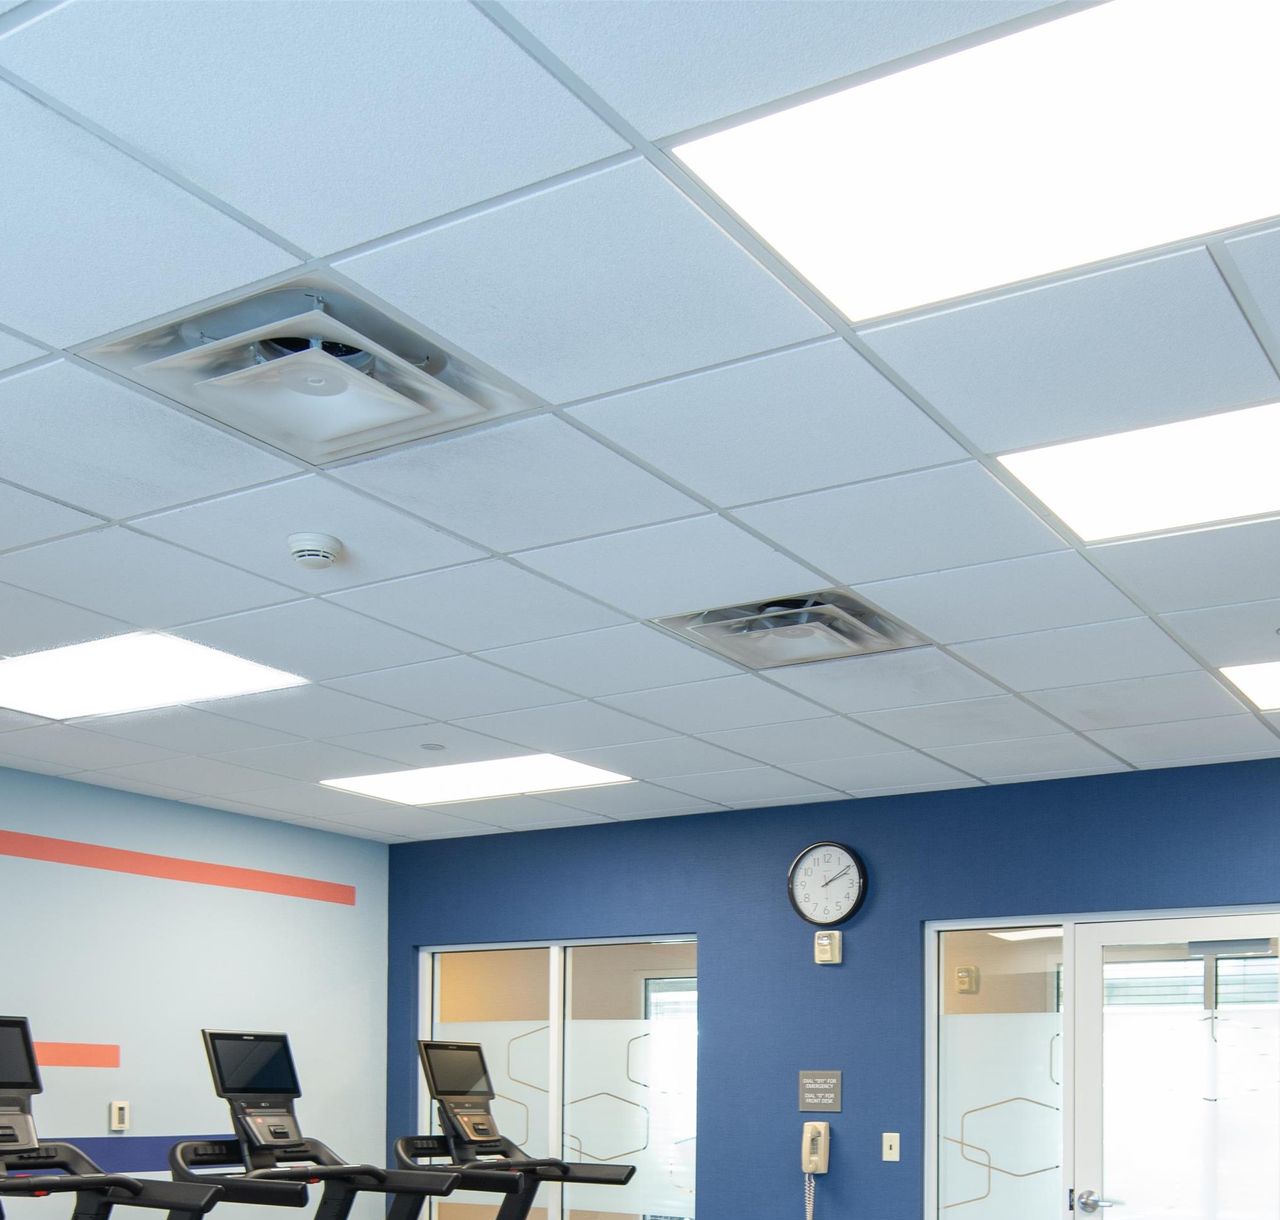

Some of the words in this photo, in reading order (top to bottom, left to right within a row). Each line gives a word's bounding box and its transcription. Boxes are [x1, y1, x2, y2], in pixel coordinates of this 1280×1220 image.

[813, 857, 820, 867] 11
[823, 853, 832, 863] 12
[804, 867, 813, 877] 10
[800, 881, 807, 890] 9
[848, 879, 854, 889] 3
[804, 893, 810, 903] 8
[844, 892, 851, 902] 4
[812, 903, 819, 912] 7
[823, 906, 831, 916] 6
[835, 901, 842, 911] 5
